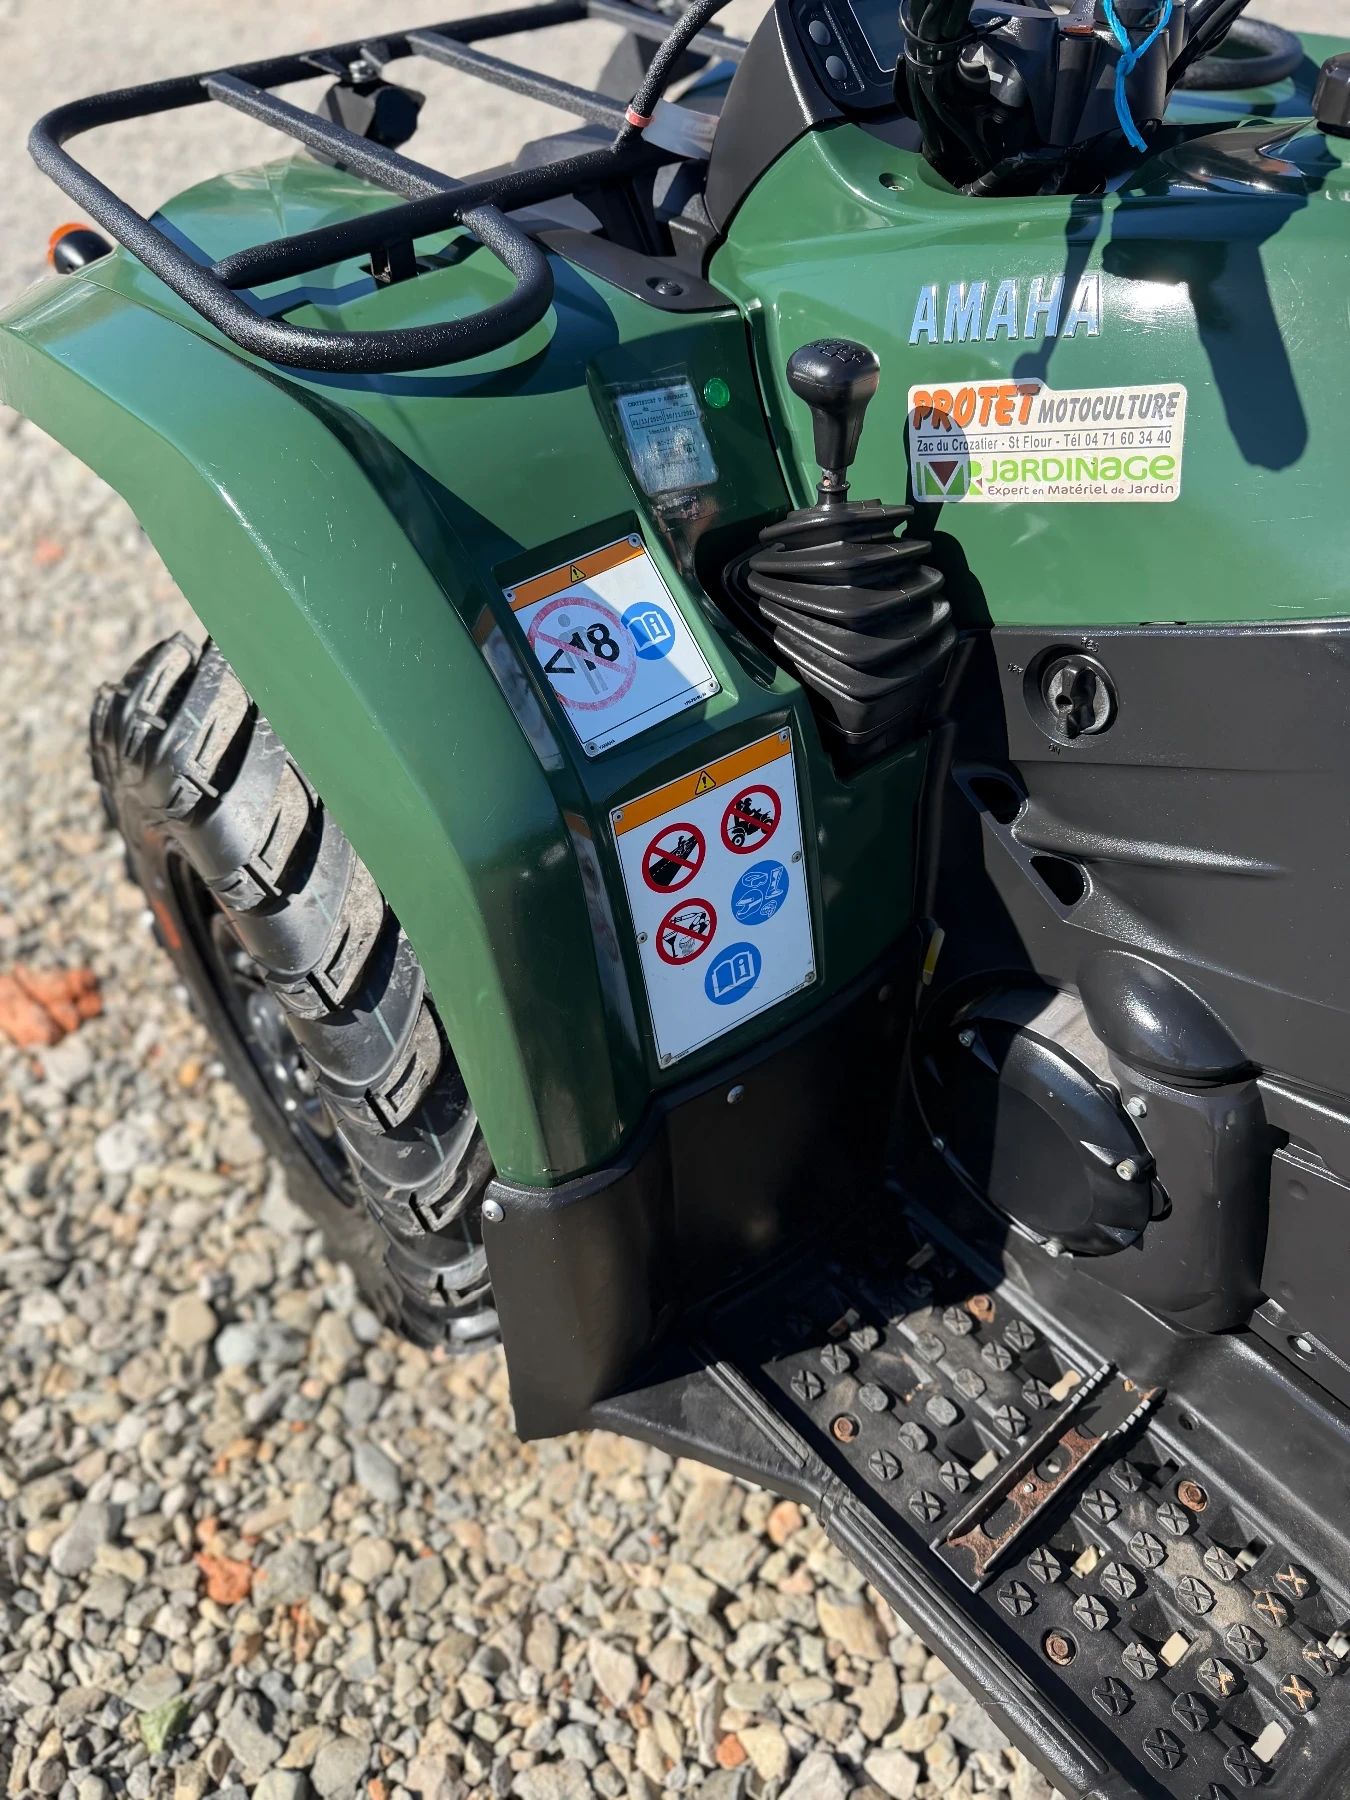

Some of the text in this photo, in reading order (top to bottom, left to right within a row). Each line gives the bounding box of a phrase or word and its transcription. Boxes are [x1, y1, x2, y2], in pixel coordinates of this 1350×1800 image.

[908, 274, 1101, 346] AMAHA
[912, 383, 1181, 432] PROTET MOTOCULTURE
[917, 440, 934, 452] Zac
[937, 440, 949, 452] du
[951, 438, 998, 451] Crozatier
[1008, 436, 1020, 449] St
[1023, 435, 1052, 448] Flour
[1064, 433, 1081, 447] Tél
[1085, 433, 1099, 446] 04
[1102, 432, 1115, 445] 71
[1120, 431, 1134, 445] 60
[1138, 431, 1153, 445] 34
[1157, 430, 1172, 444] 40
[987, 485, 1030, 496] Expert
[1047, 483, 1108, 495] Matériel
[1127, 483, 1174, 494] Jardin
